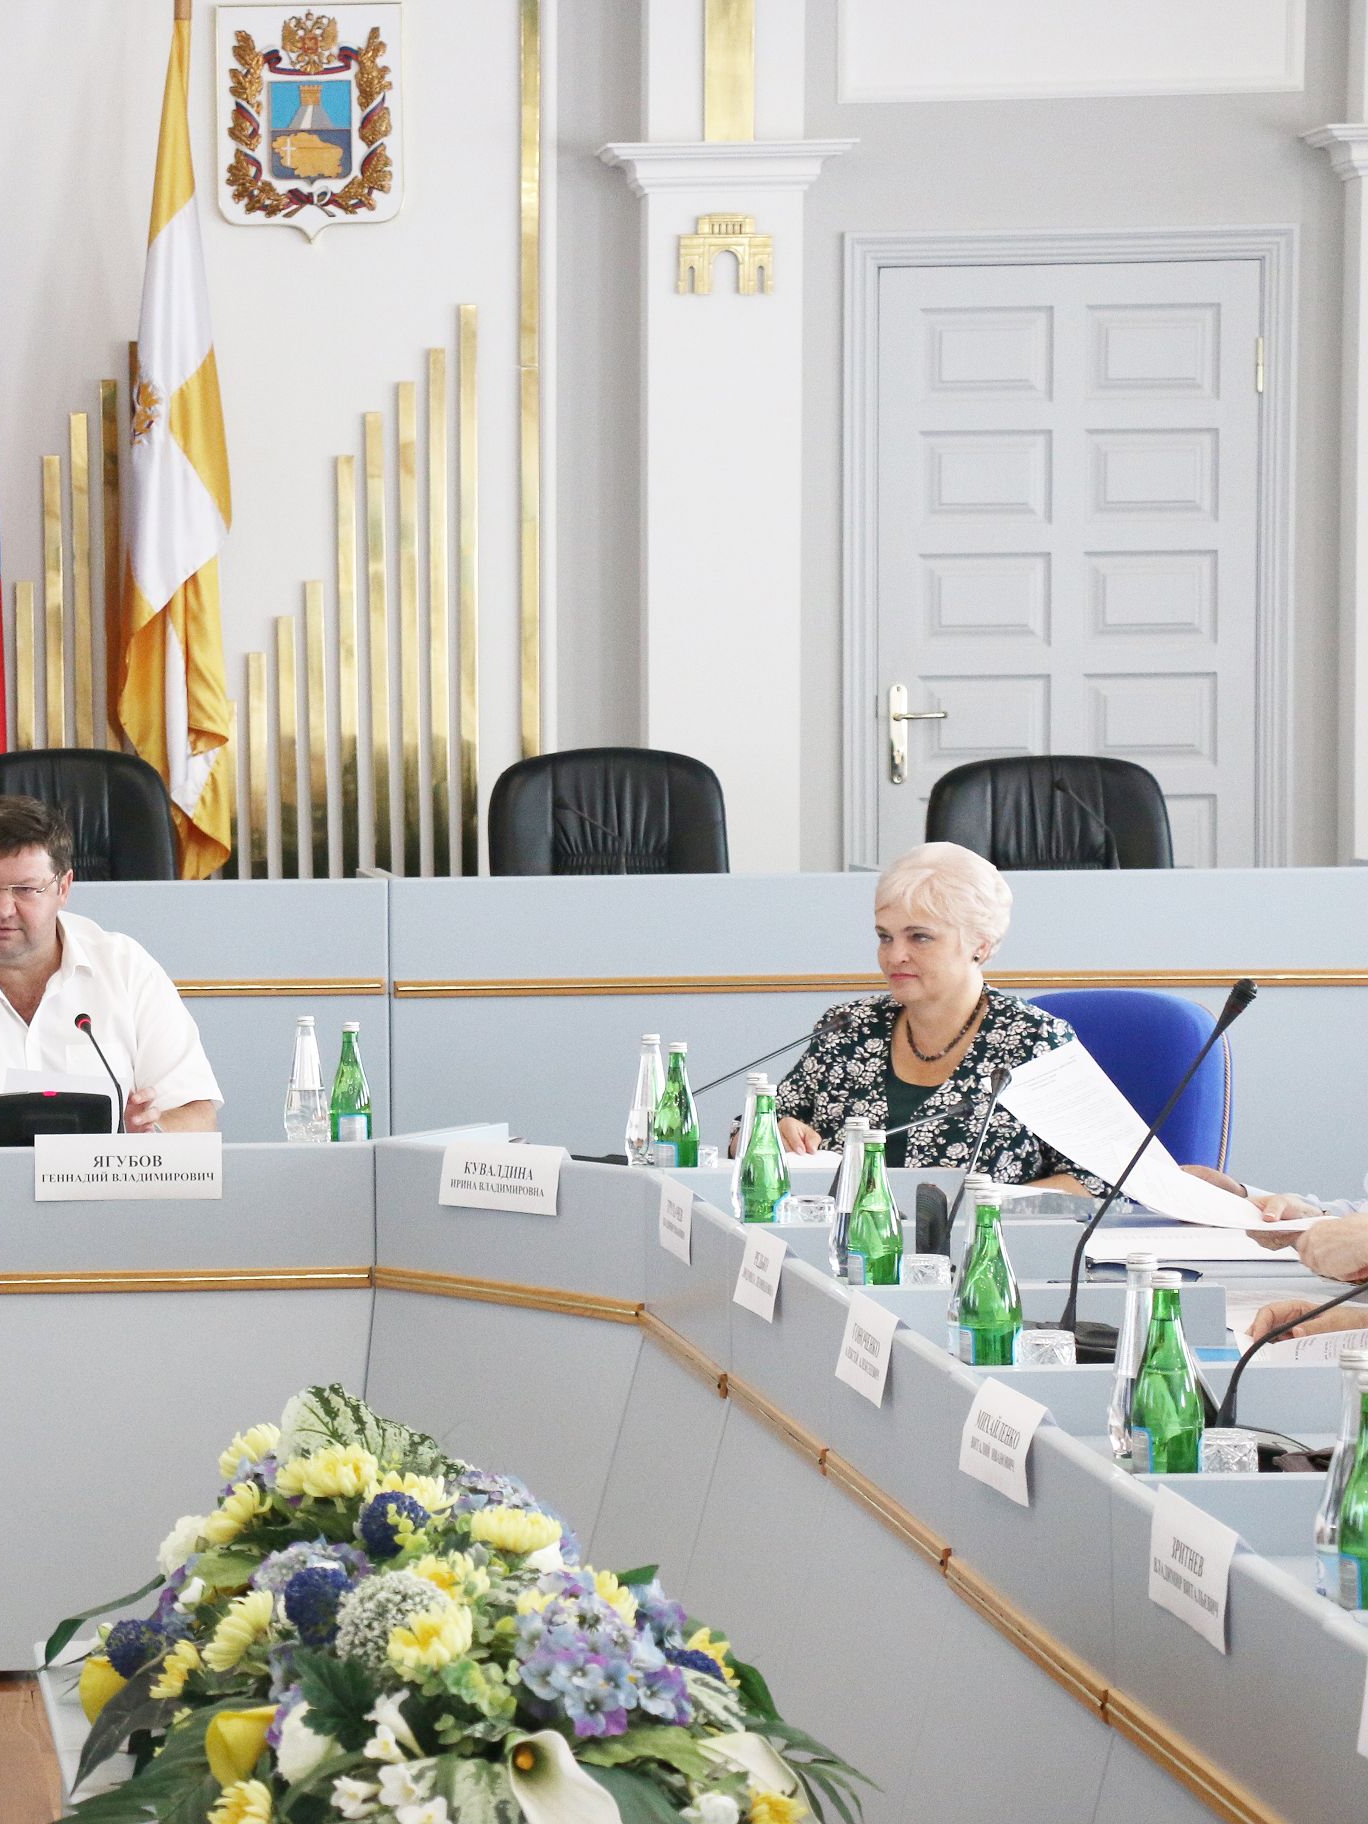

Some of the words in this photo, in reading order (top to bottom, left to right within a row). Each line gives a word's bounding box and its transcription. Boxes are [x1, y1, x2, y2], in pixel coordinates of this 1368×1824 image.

[93, 1154, 163, 1168] ЯГУБОВ
[464, 1161, 533, 1180] КУВАЛДИНА
[41, 1171, 108, 1183] ГЕННАДИЙ
[112, 1172, 214, 1183] ВЛАДИМИРОВИЧ
[450, 1178, 477, 1191] ИРИНА
[479, 1182, 545, 1198] ВЛАДИМИРОВНА
[976, 1409, 1021, 1450] МИХАЙЛЕНКО
[1171, 1536, 1204, 1577] ЗРИТНЕВ
